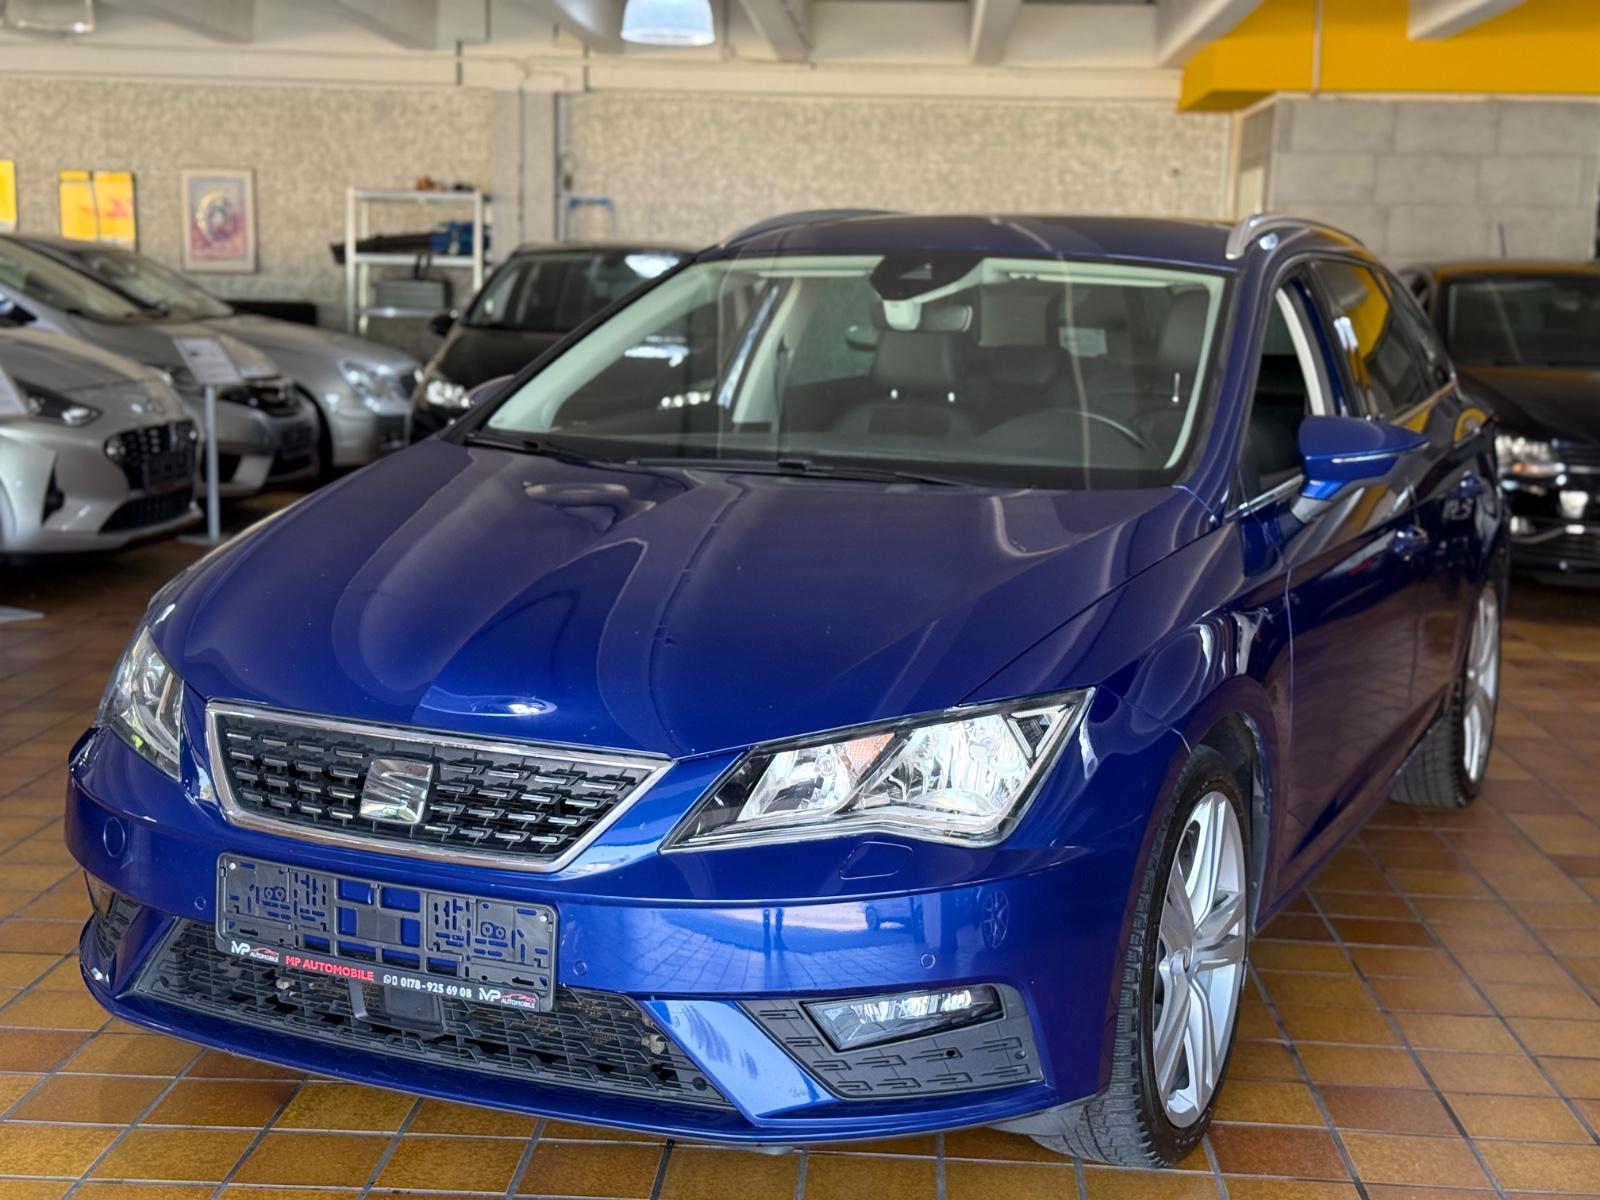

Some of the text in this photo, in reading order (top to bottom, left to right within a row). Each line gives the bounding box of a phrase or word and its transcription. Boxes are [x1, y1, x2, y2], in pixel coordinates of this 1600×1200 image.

[231, 940, 251, 955] MP
[249, 951, 279, 963] AUTOMOBILE
[285, 955, 375, 981] MP AUTOMOBILE
[446, 985, 458, 996] 69
[460, 987, 472, 998] 08
[479, 987, 501, 1002] MP
[501, 998, 536, 1009] AUTOMOBILE
